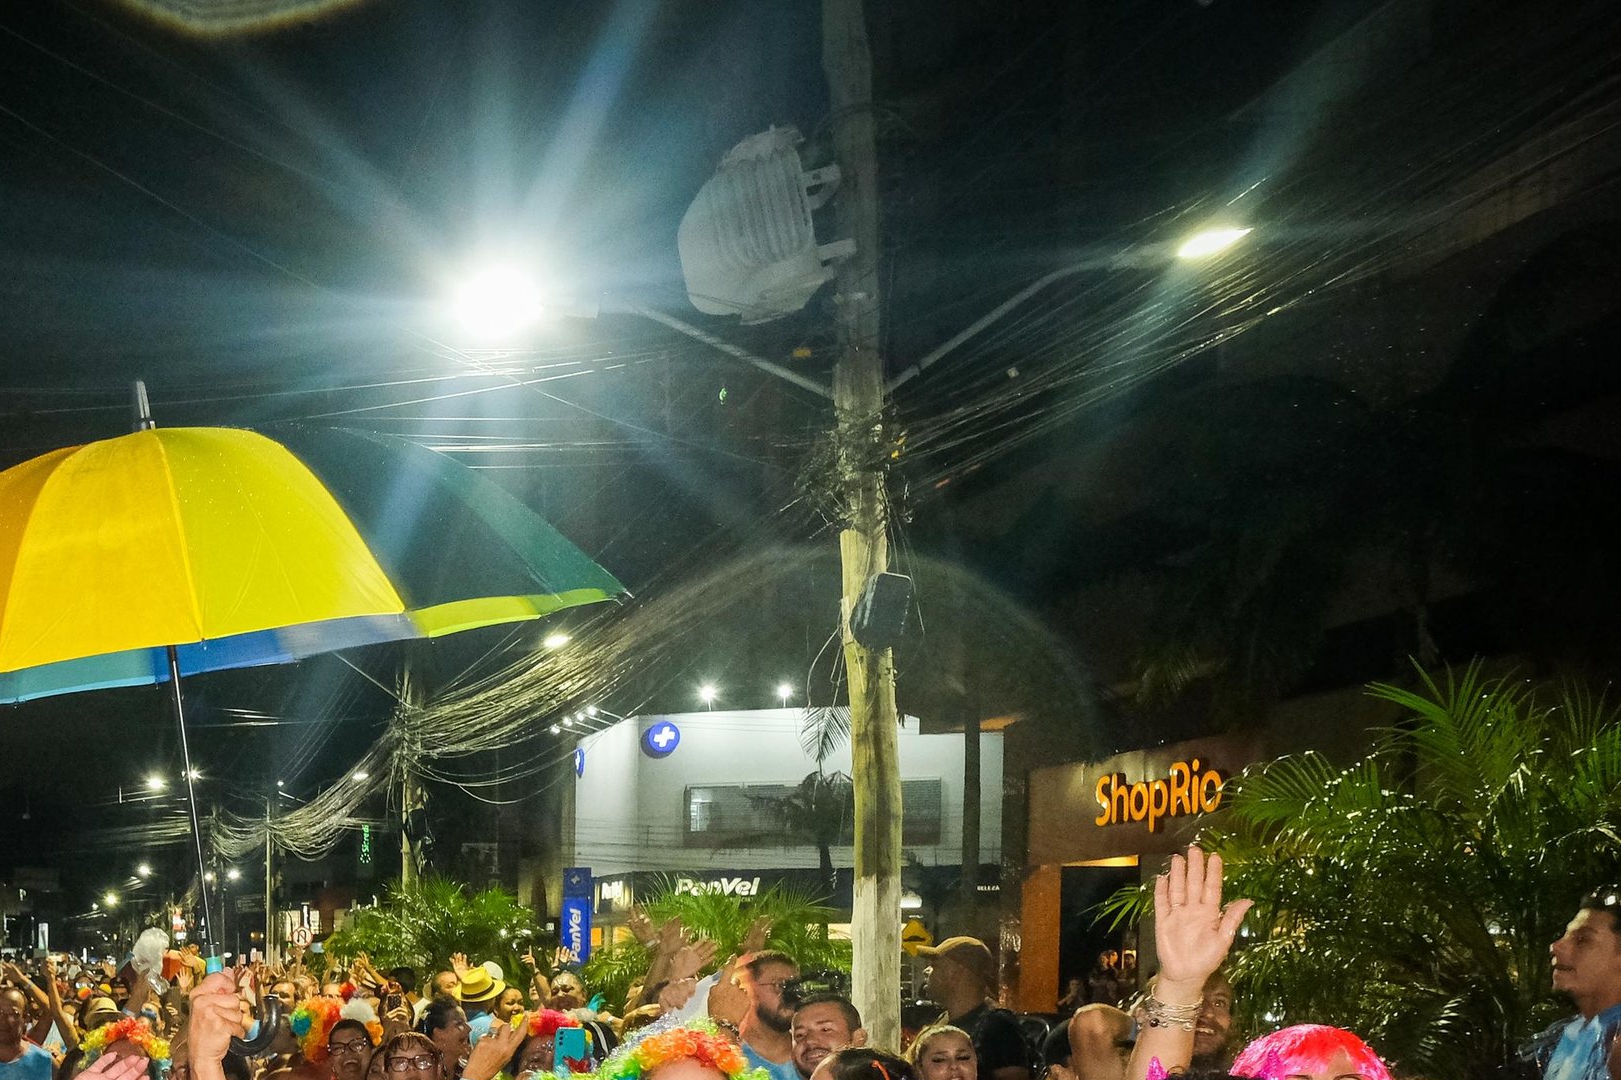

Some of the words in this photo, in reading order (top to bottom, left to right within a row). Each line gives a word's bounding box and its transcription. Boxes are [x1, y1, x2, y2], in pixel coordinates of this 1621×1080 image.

[1095, 758, 1223, 833] ShopRio
[674, 877, 761, 898] PanVel
[569, 907, 583, 963] PanVel
